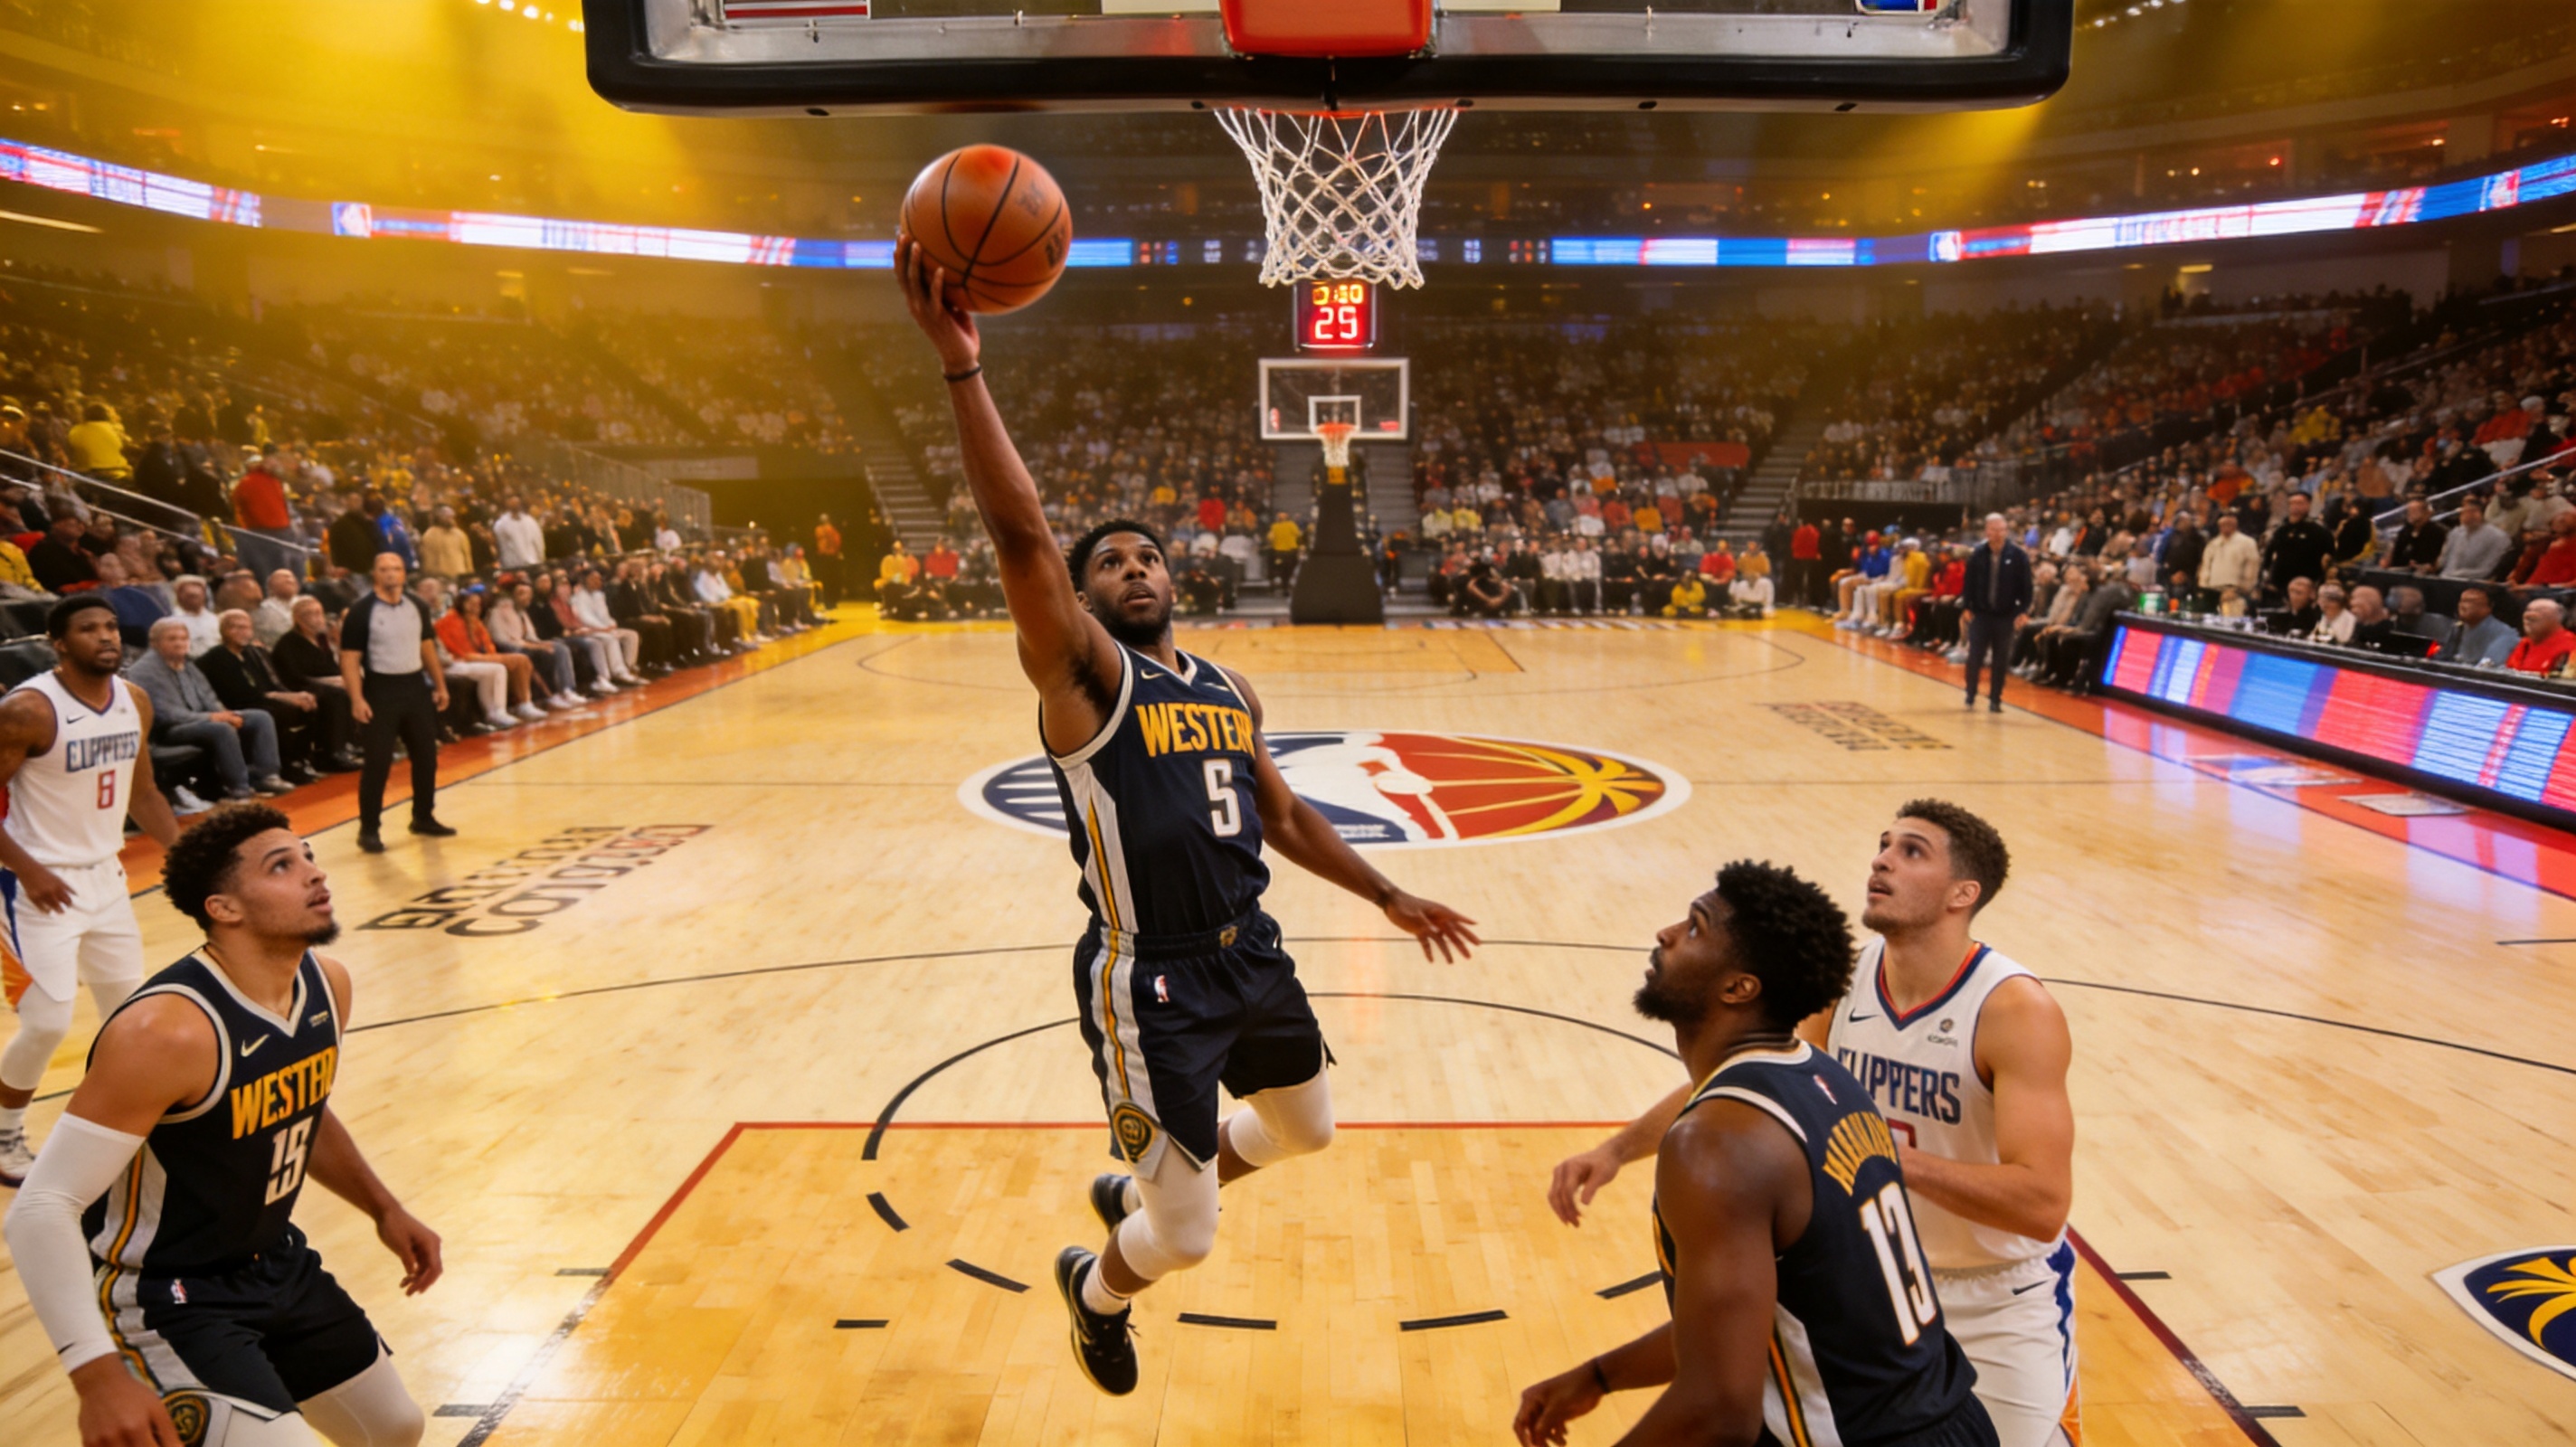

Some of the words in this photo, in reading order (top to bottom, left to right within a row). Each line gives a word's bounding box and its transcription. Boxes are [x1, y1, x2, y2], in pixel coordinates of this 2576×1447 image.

[97, 769, 117, 811] 8
[1202, 758, 1243, 838] 5
[1858, 1180, 1937, 1347] 13
